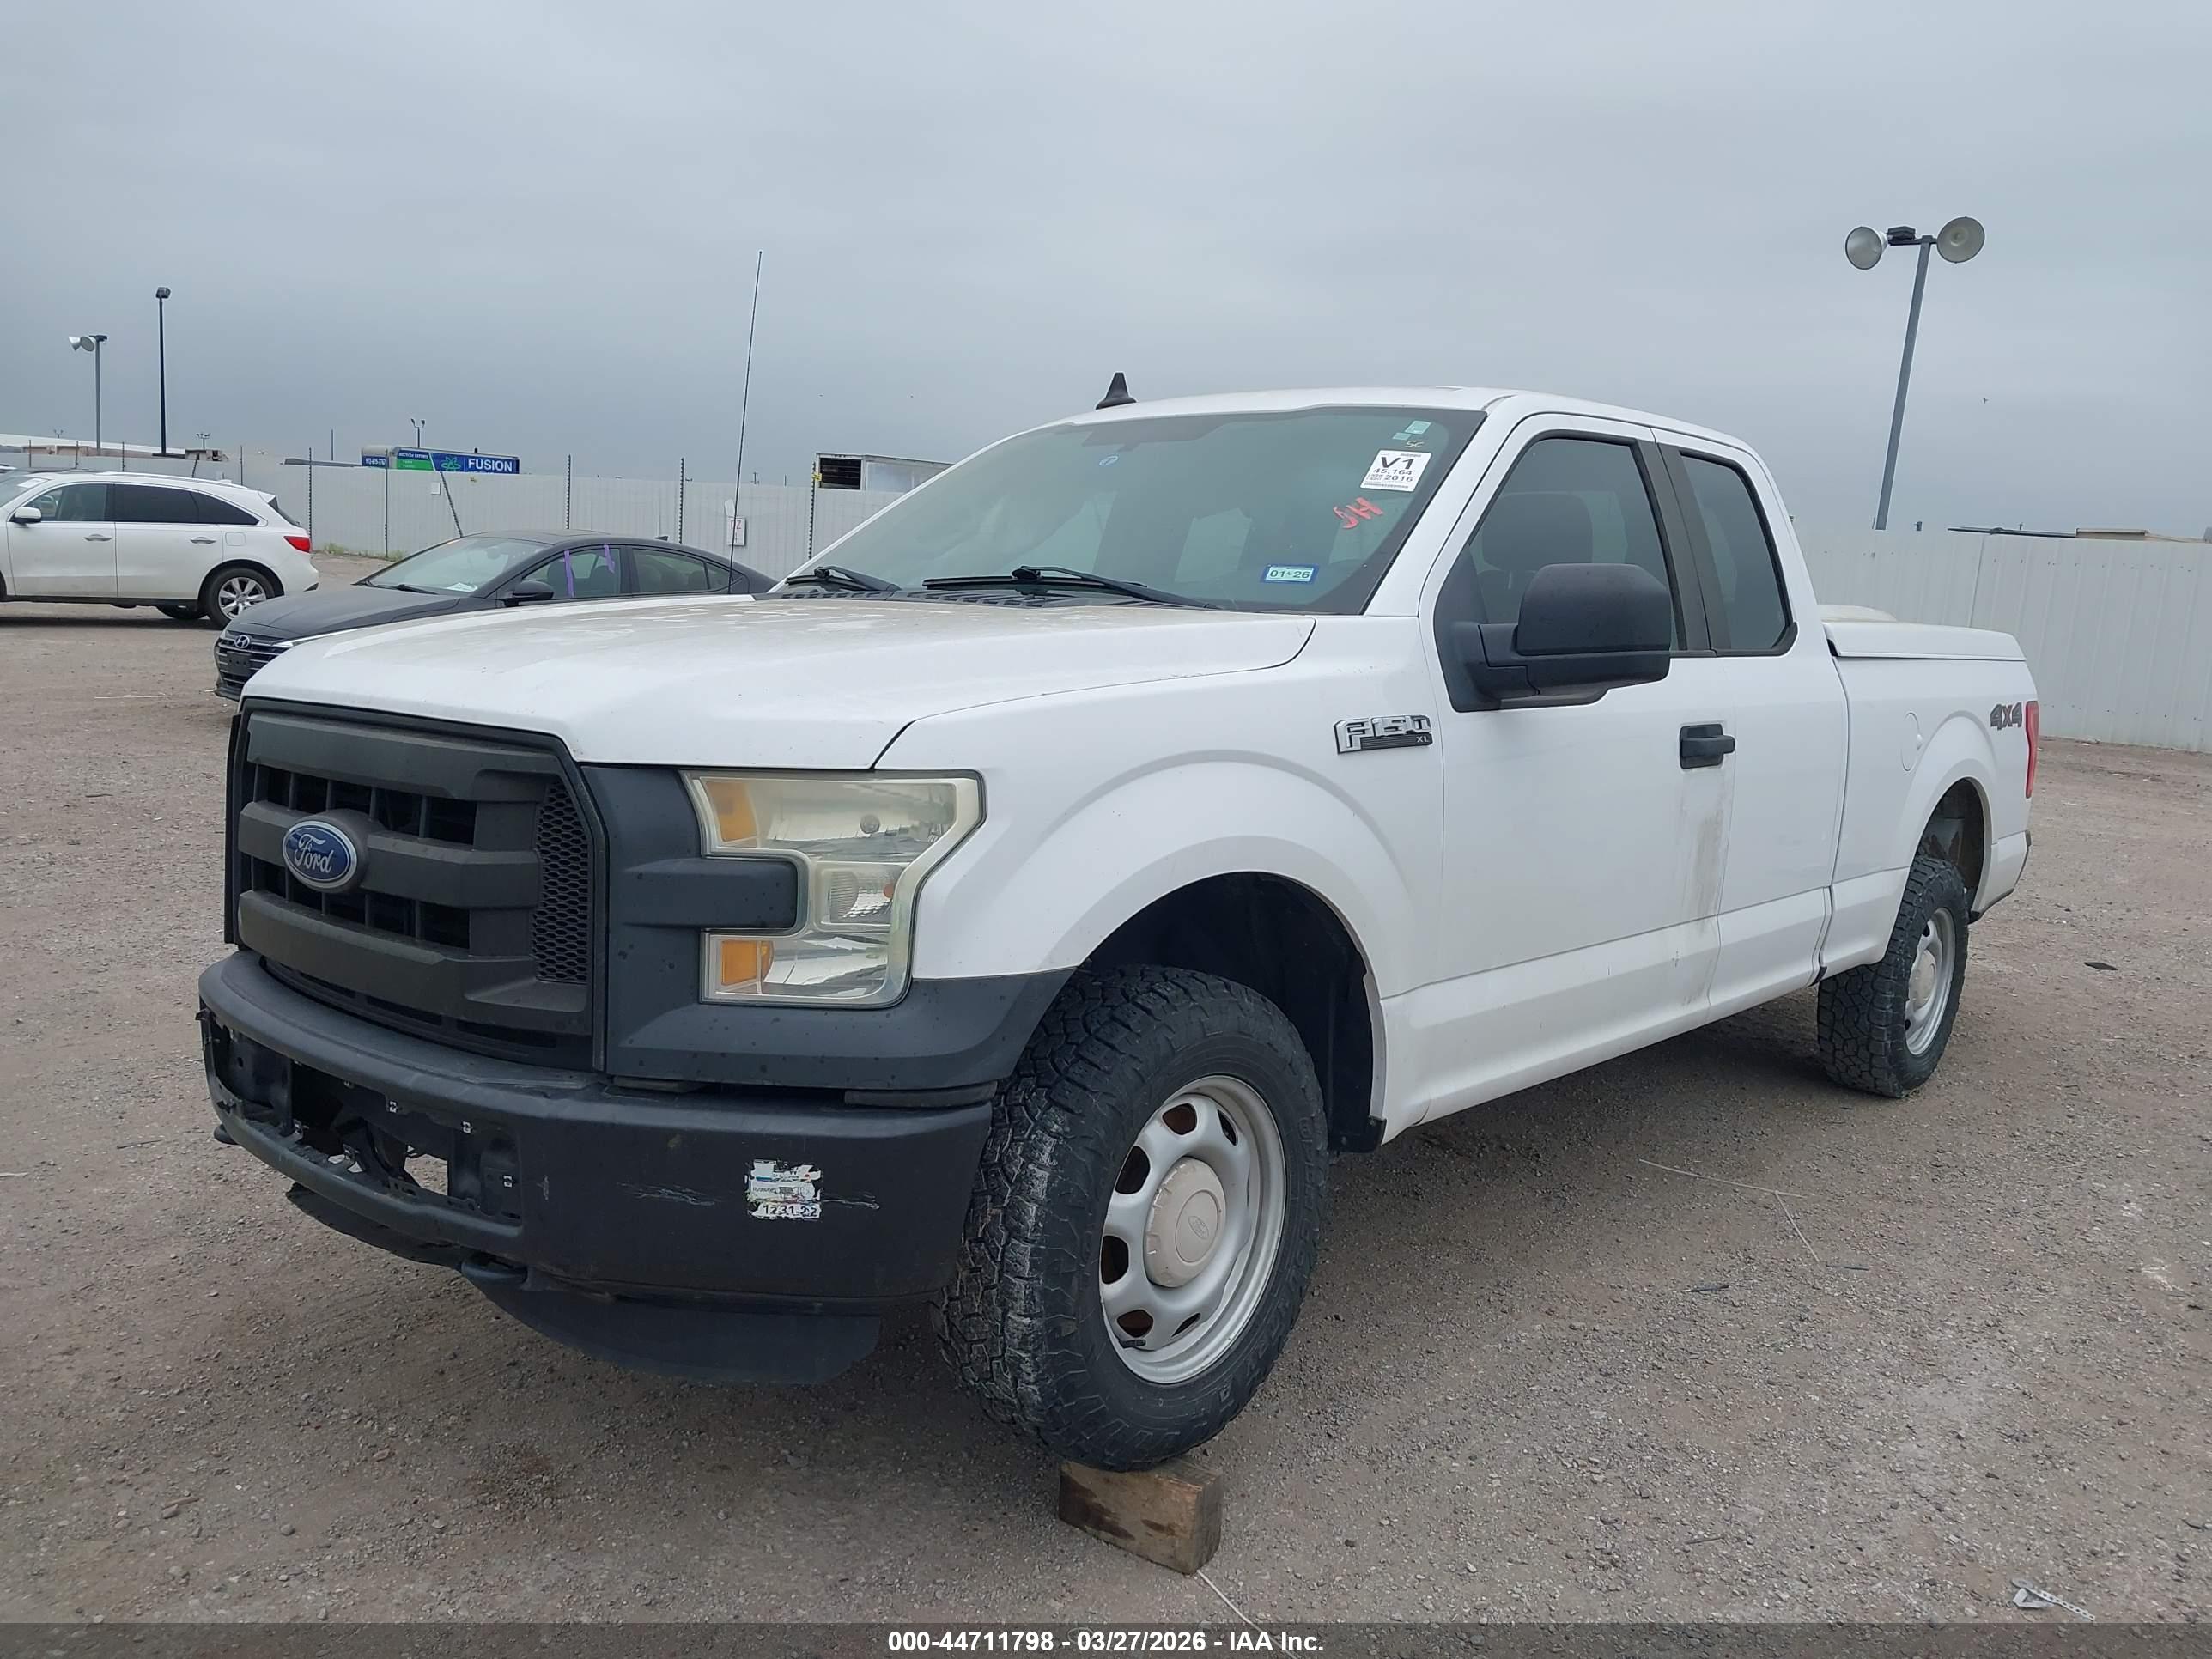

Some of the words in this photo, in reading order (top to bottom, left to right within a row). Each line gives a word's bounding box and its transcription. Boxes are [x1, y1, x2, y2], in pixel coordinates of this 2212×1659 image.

[468, 458, 513, 472] FUSION
[1381, 456, 1415, 470] V1
[294, 832, 334, 873] Ford
